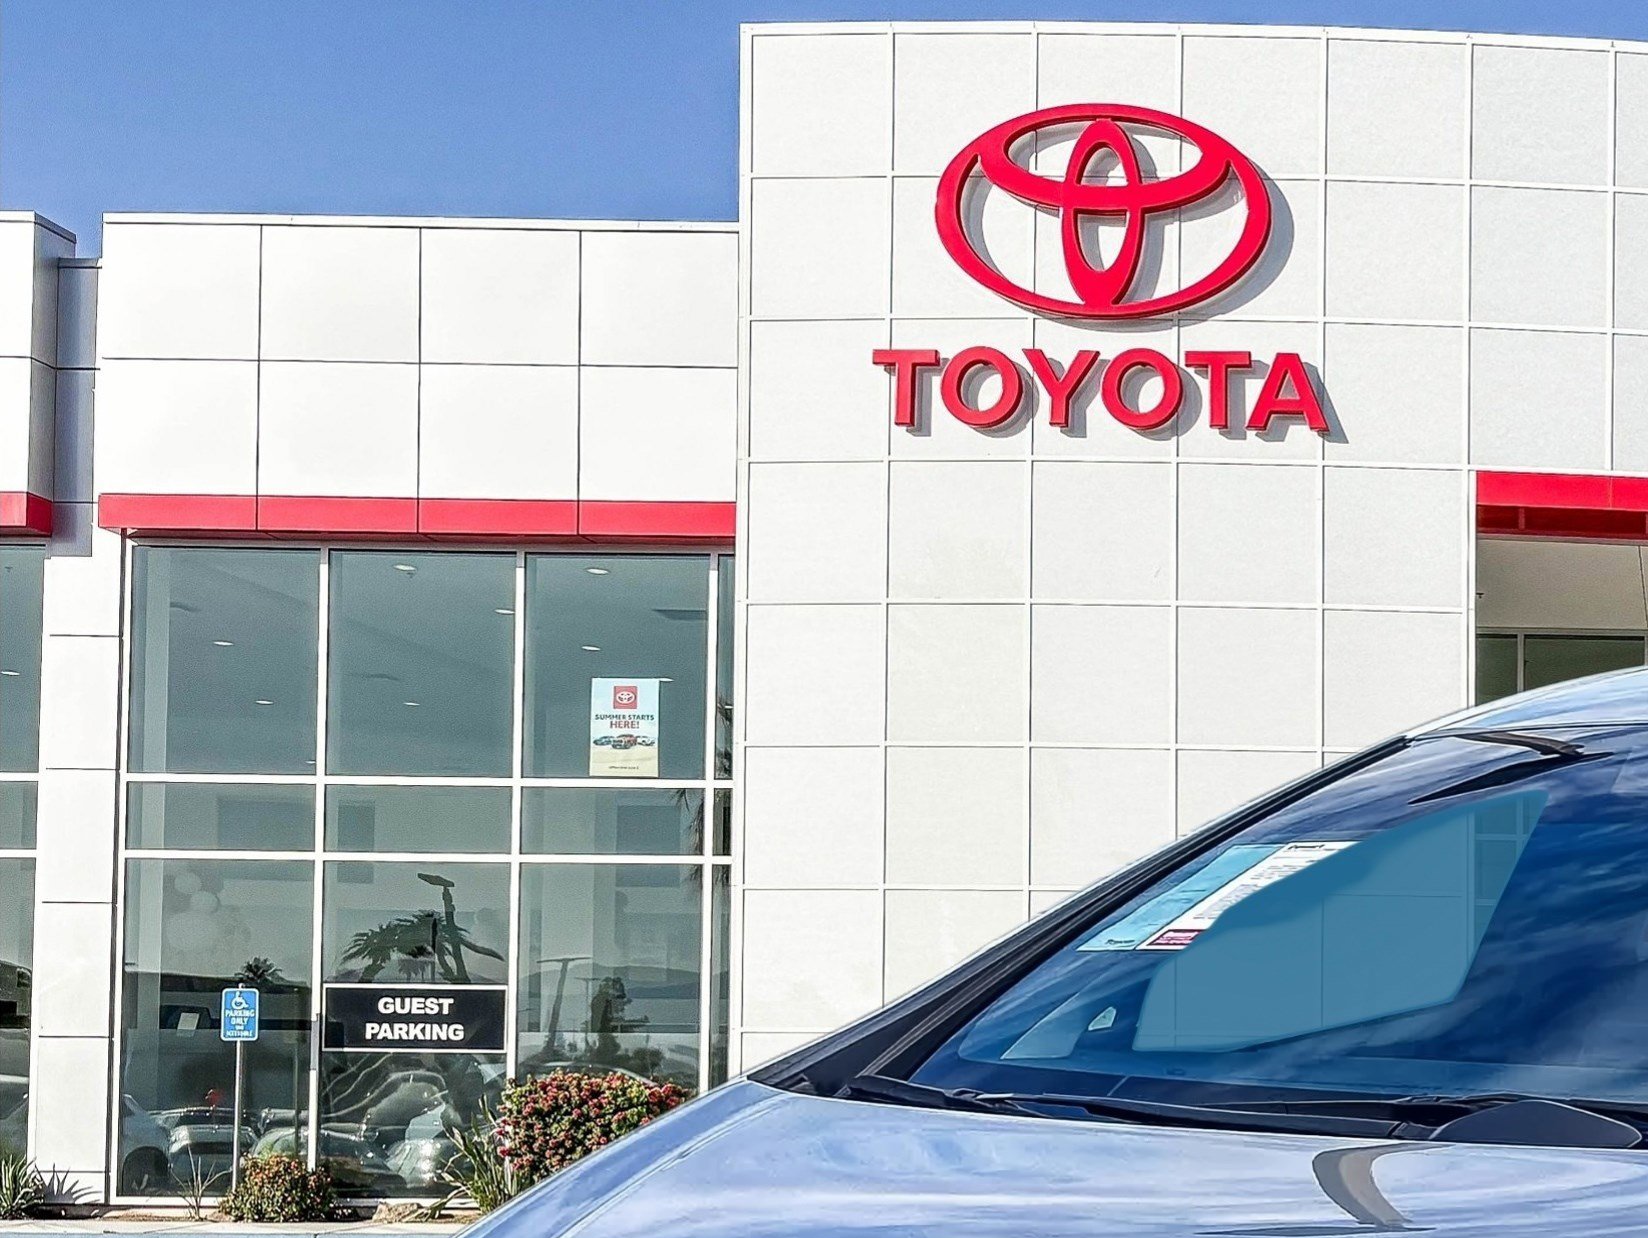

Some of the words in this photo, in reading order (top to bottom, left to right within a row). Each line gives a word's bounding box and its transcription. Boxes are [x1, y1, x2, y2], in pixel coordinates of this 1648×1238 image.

[872, 345, 1330, 432] TOYOTA
[609, 720, 640, 729] HERE!
[378, 997, 454, 1015] GUEST
[365, 1023, 464, 1041] PARKING
